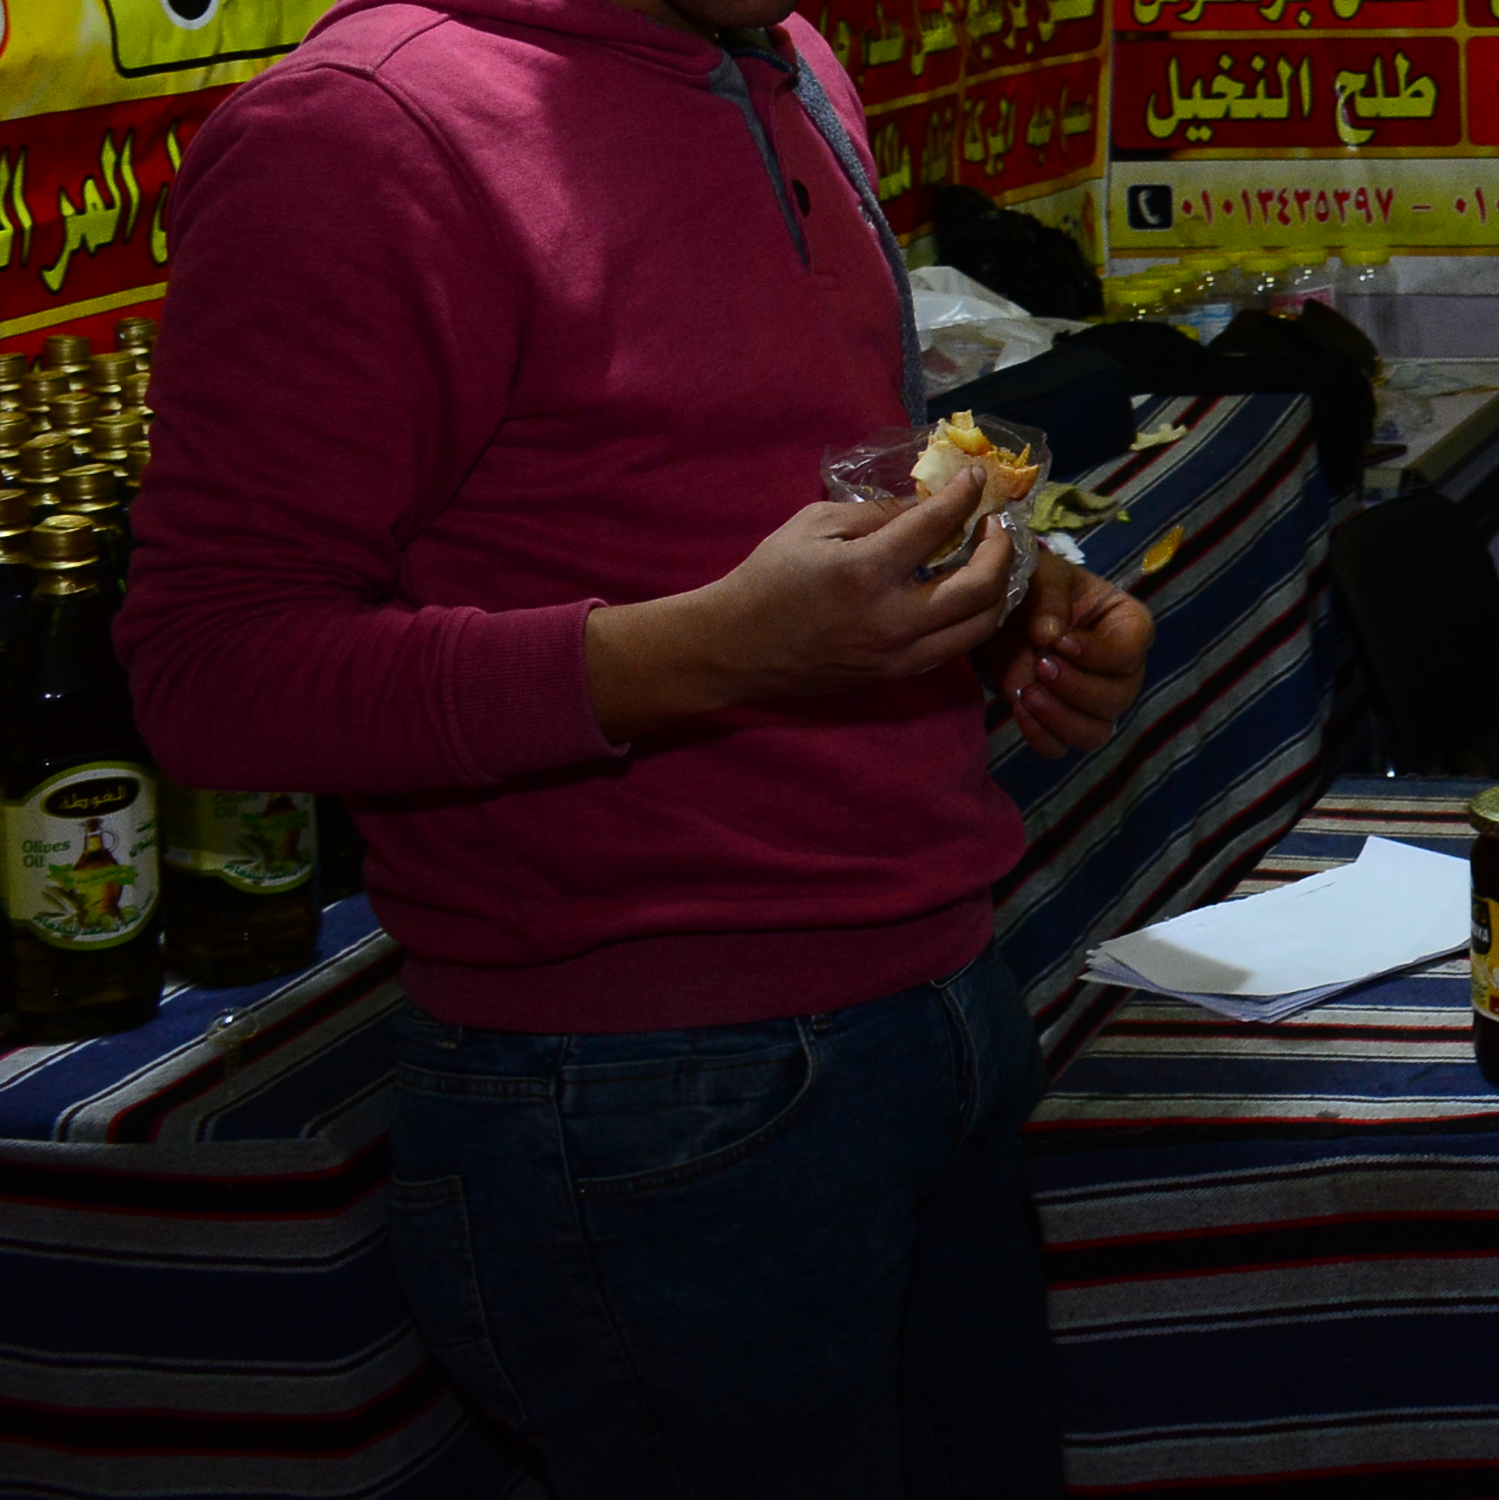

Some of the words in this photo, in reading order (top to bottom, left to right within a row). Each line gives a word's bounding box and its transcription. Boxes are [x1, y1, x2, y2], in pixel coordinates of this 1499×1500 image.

[1145, 52, 1314, 143] النخيل
[22, 840, 71, 855] Olives
[23, 855, 47, 868] Oil
